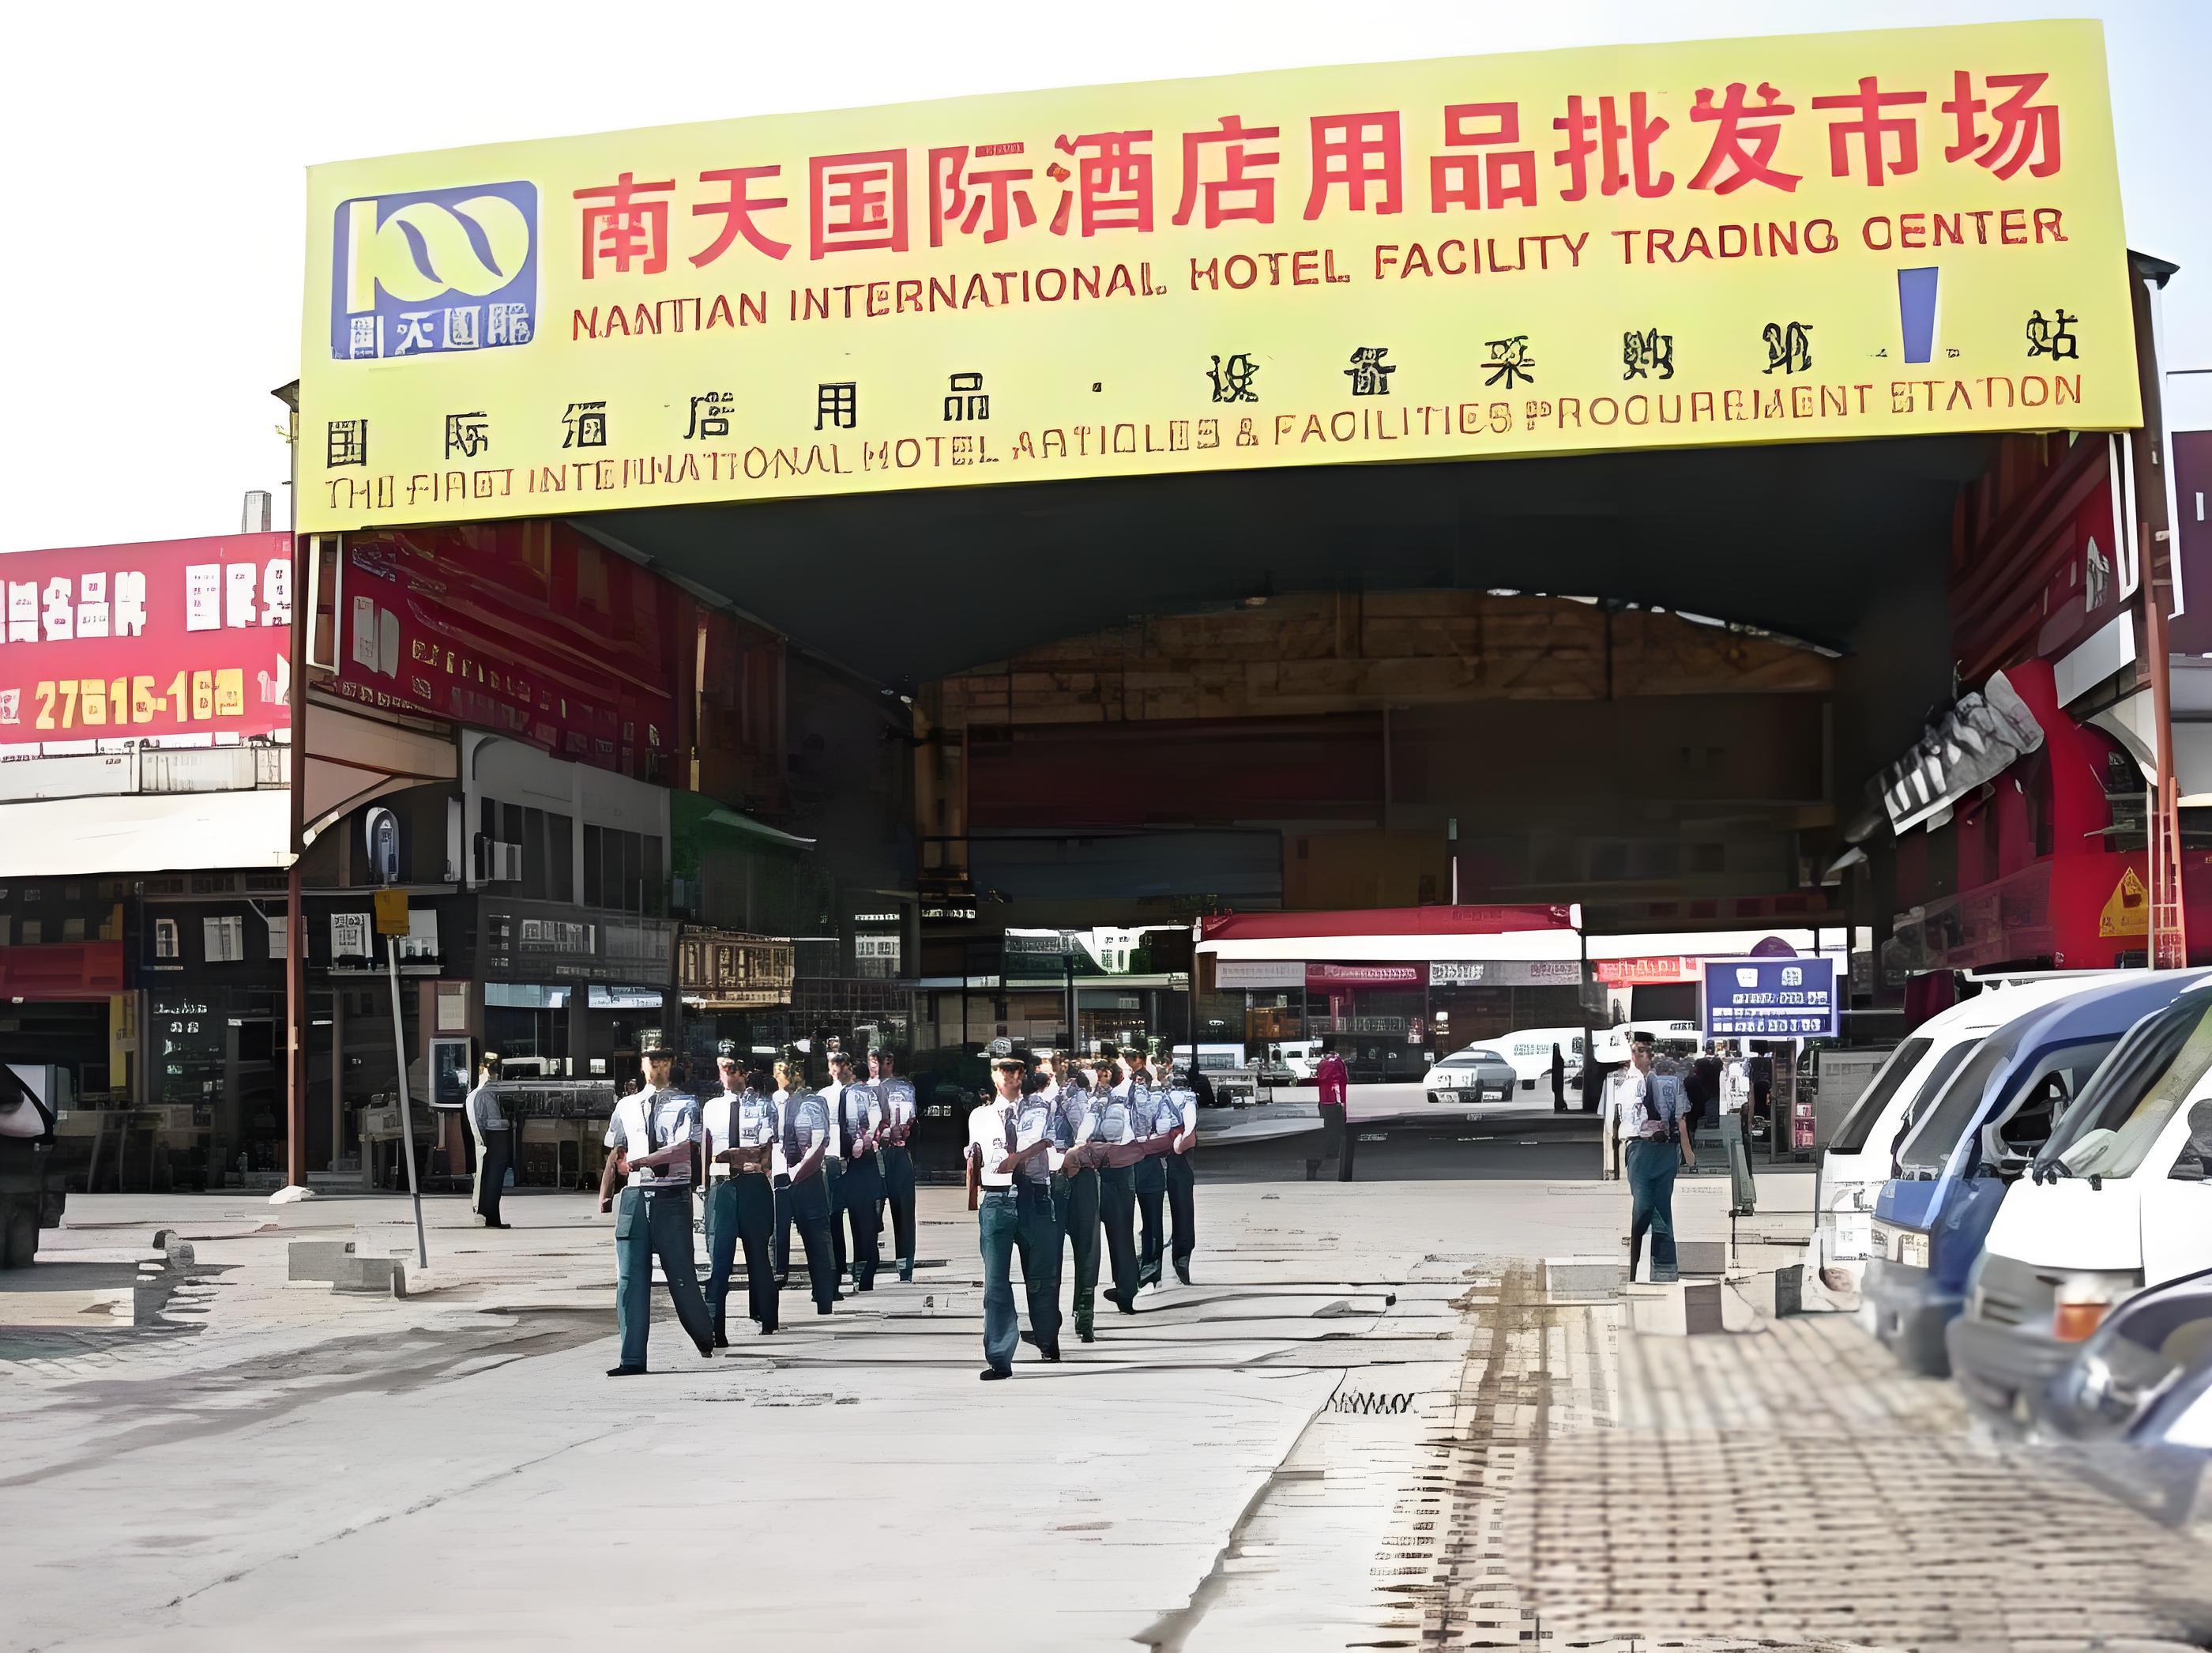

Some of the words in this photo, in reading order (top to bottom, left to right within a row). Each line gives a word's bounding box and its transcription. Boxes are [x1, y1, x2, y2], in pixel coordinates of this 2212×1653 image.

[574, 70, 2062, 279] 南天国际酒店用品批发市场
[573, 291, 766, 341] NANTIAN
[791, 262, 1160, 321] INTERNATIONAL
[1191, 250, 1345, 290] HOTEL
[1375, 232, 1589, 279] FACILITY
[1612, 219, 1838, 264] TRADING
